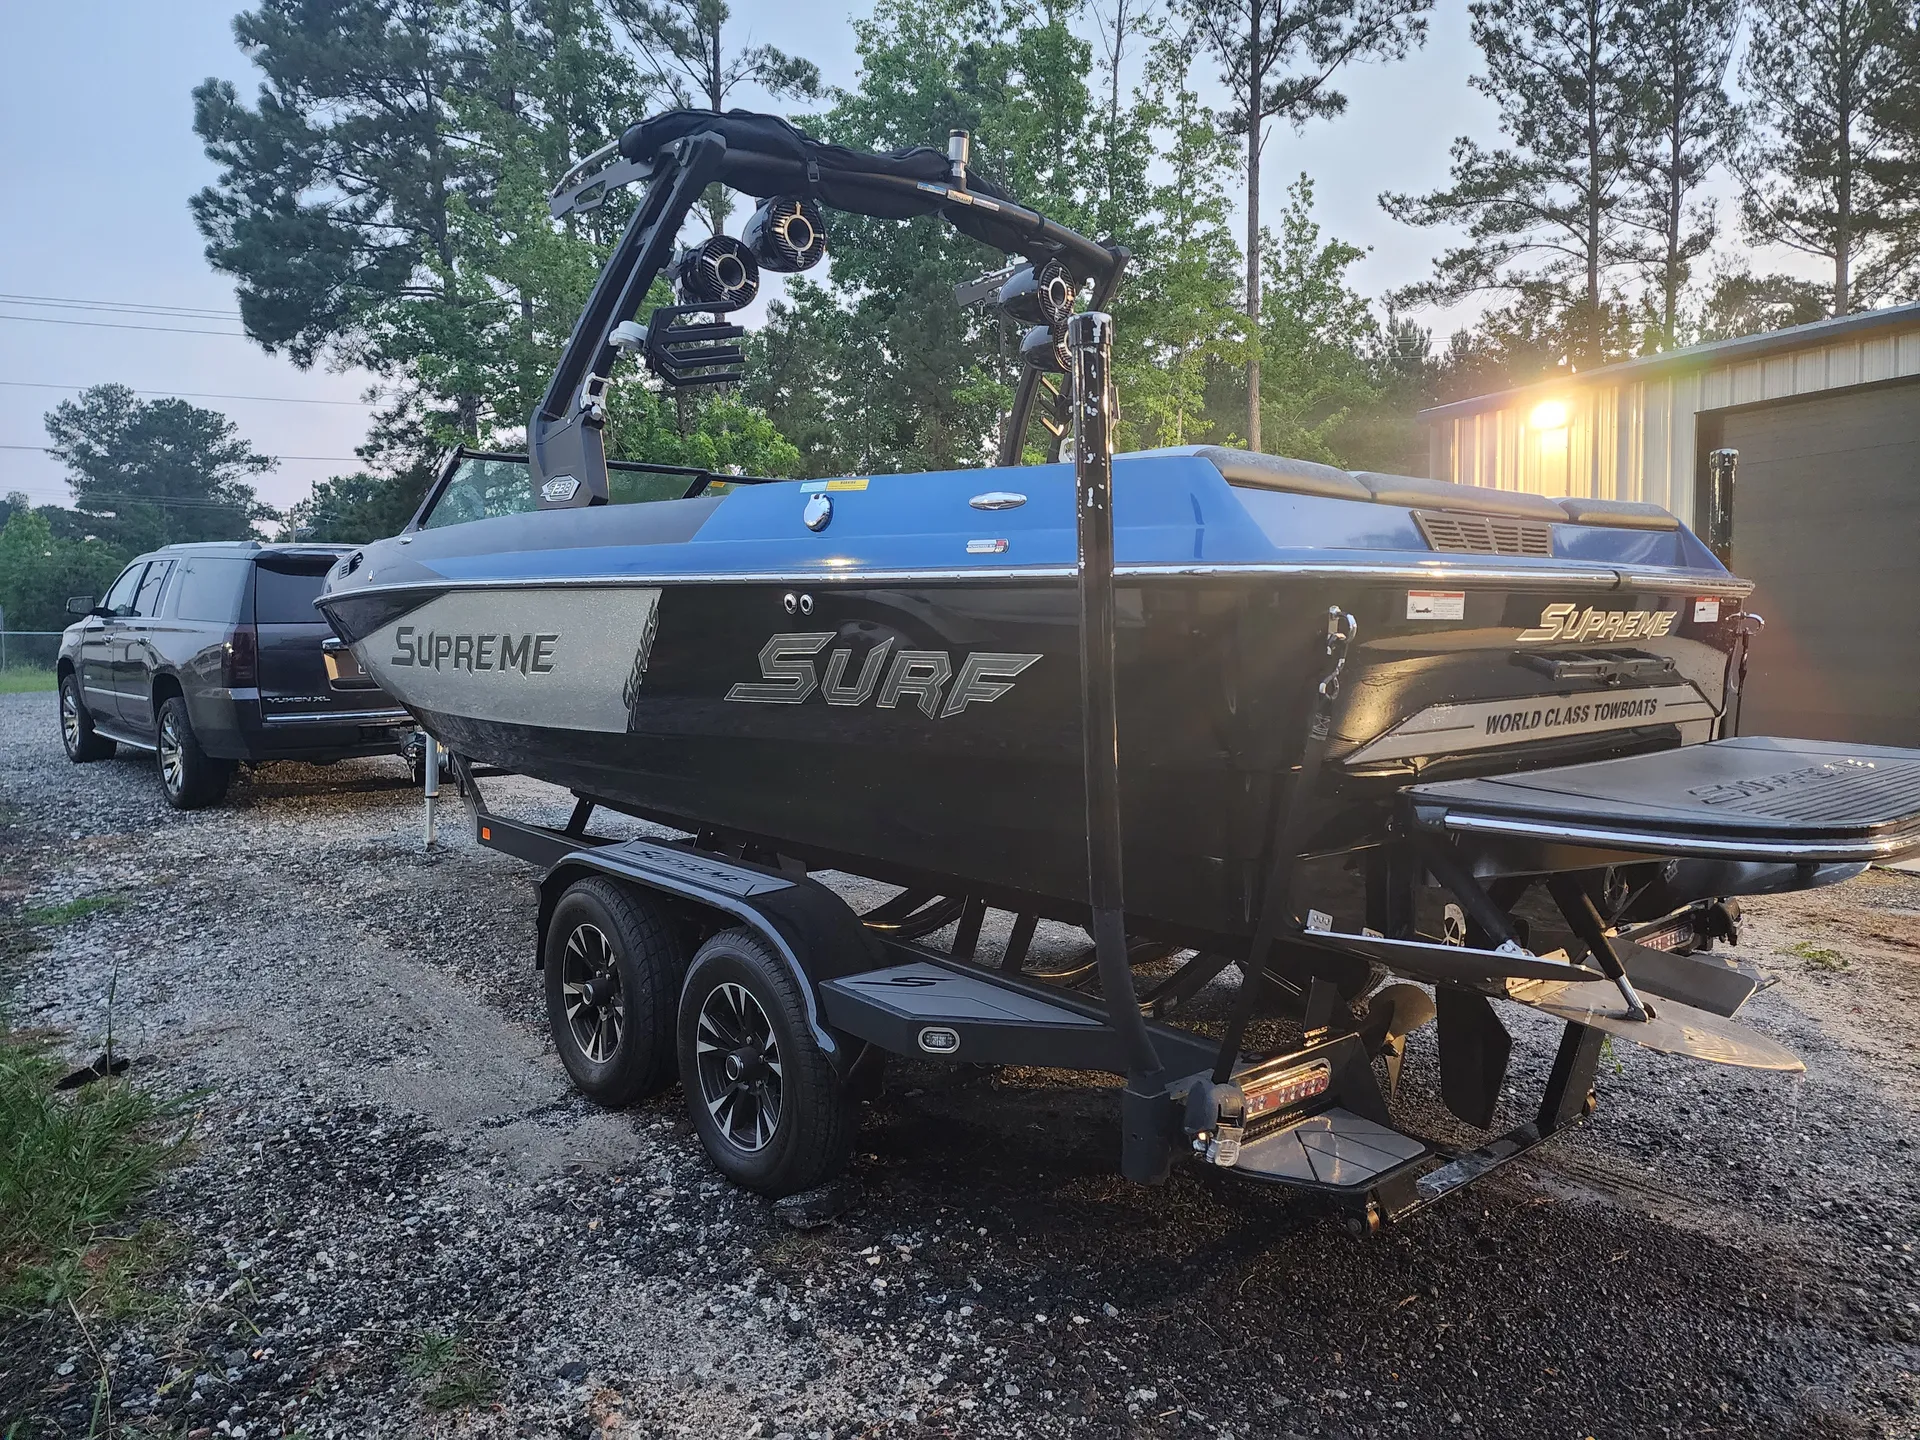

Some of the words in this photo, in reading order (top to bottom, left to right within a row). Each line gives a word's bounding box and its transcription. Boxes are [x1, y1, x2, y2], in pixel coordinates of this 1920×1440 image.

[1516, 602, 1678, 643] SUPREME
[390, 626, 563, 681] SUPREME
[723, 631, 1044, 720] SURF
[266, 695, 312, 704] YUKON
[313, 695, 331, 703] XL
[1484, 709, 1542, 736] WORLD
[1544, 703, 1591, 728] CLASS
[1593, 698, 1658, 722] TOWBOATS
[623, 849, 752, 883] SUPREME
